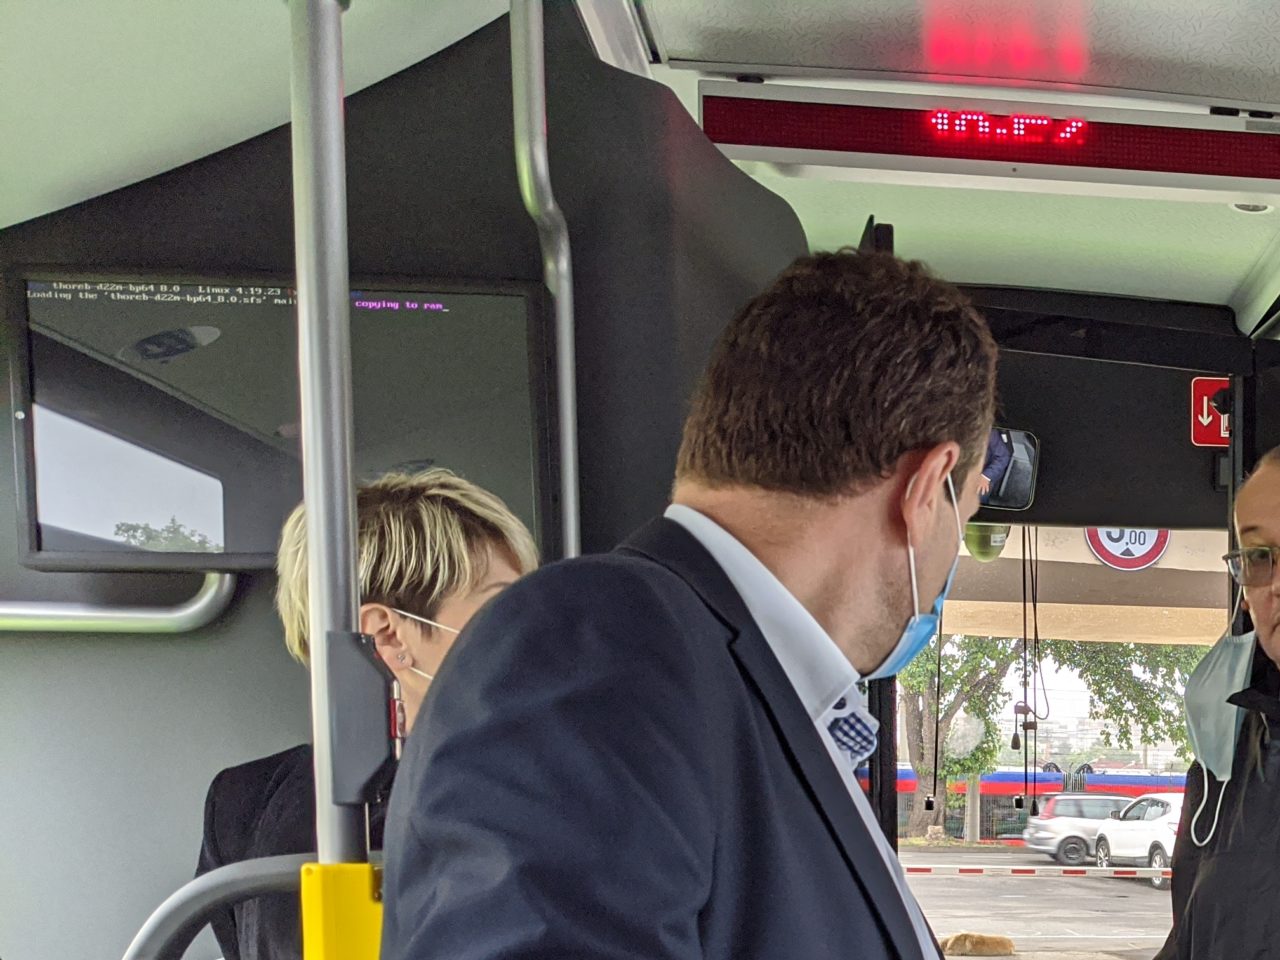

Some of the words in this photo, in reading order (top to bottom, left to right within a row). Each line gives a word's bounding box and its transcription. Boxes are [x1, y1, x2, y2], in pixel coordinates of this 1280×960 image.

[198, 285, 230, 294] Linux
[27, 290, 72, 301] Loading
[79, 291, 98, 300] the
[355, 300, 399, 310] copying
[405, 301, 418, 309] to
